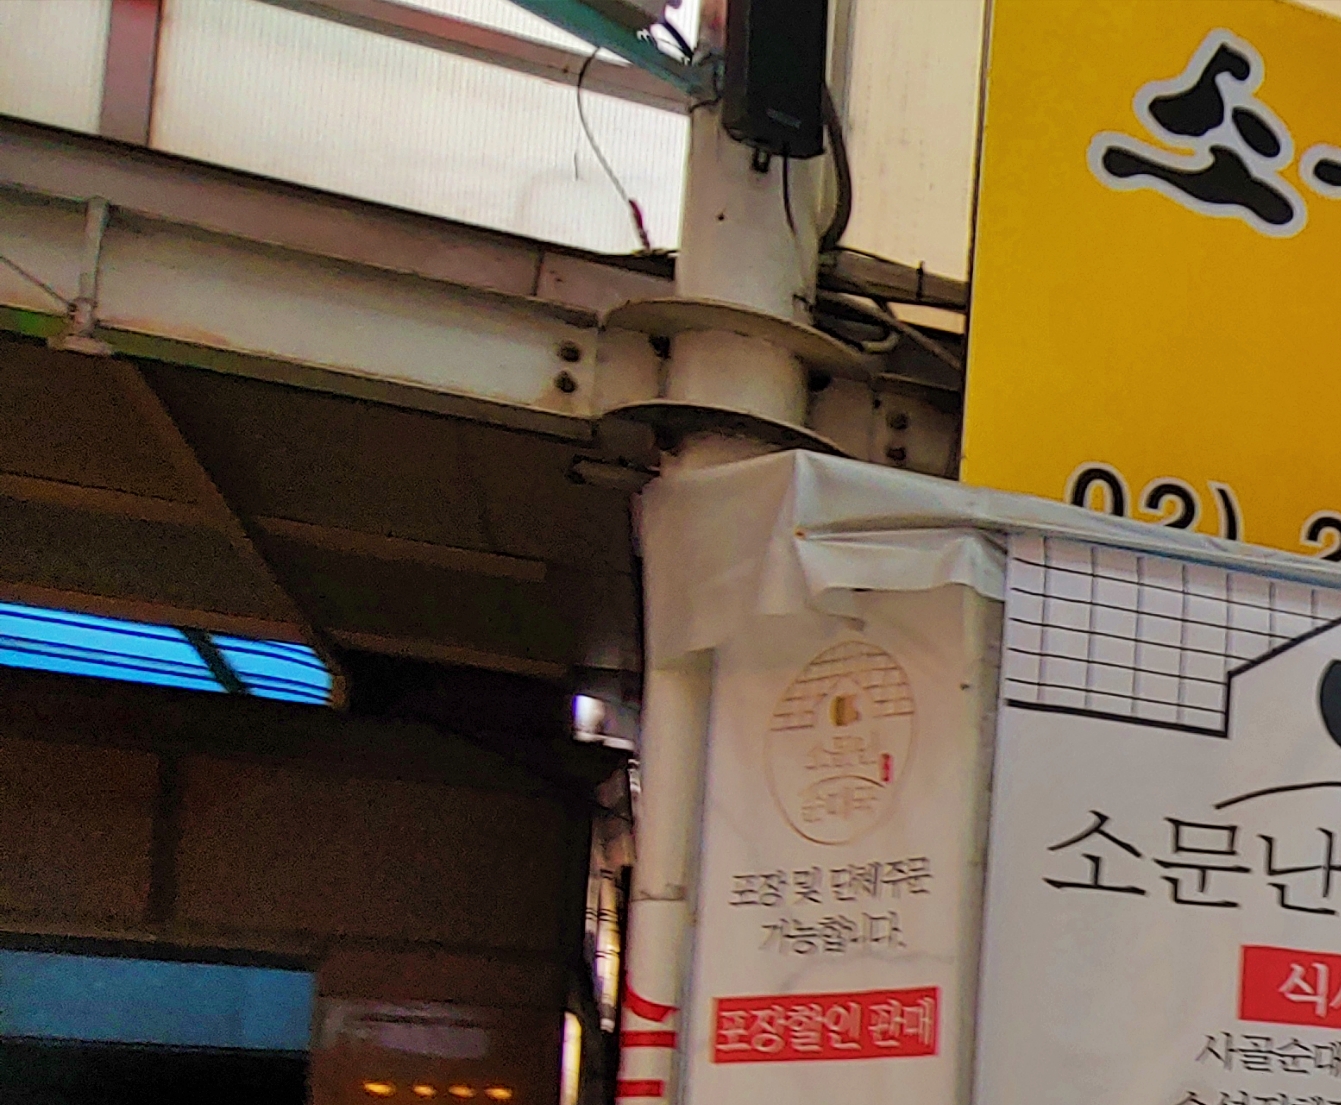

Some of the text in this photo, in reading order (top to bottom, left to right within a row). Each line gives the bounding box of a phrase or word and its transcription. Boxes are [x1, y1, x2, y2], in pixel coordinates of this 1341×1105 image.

[729, 869, 788, 907] 포장
[792, 866, 822, 904] 및
[716, 995, 933, 1055] 포장할인 판매
